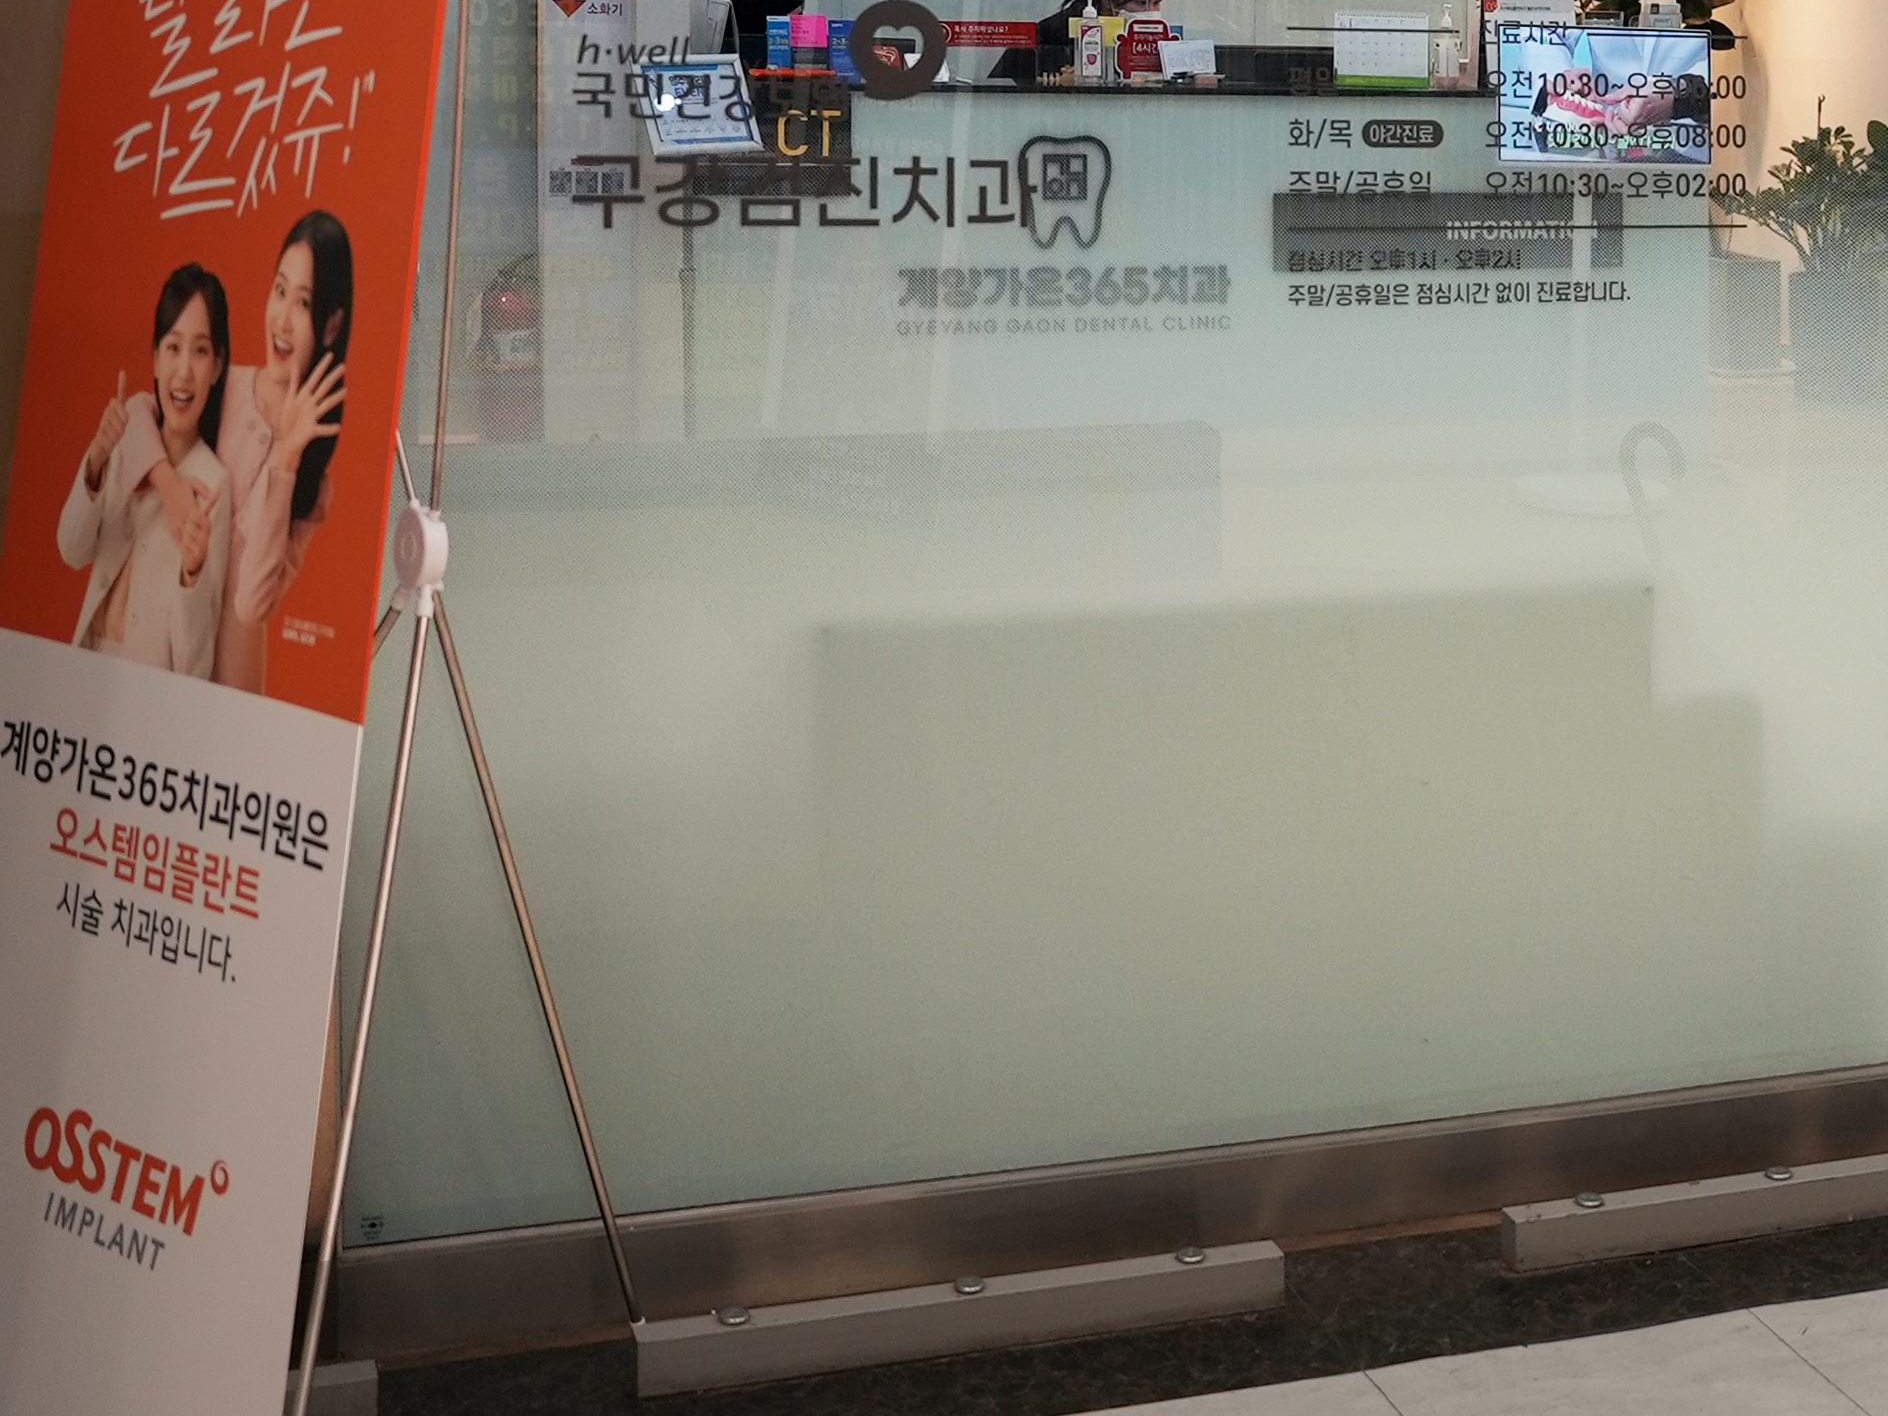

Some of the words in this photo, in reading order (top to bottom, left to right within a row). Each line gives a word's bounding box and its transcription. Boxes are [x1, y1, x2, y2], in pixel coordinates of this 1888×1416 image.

[587, 2, 623, 16] 소화기
[1481, 19, 1569, 46] 진료시간
[1289, 118, 1353, 150] 화/목
[1367, 124, 1435, 146] 야간진료
[571, 155, 1038, 230] 구강검진치과
[1288, 169, 1432, 197] 주말/공휴일
[898, 265, 1231, 308] 계양가온365치과
[1288, 283, 1410, 308] 주말/공휴일은
[1416, 282, 1490, 306] 점심시간
[1495, 282, 1531, 305] 없이
[1536, 280, 1632, 303] 진료합니다.
[2, 716, 330, 872] 계양가온365치과의원은
[50, 807, 261, 921] 오스템임플란트
[57, 881, 105, 936] 시술
[110, 899, 237, 983] 치과입니다.
[24, 1106, 204, 1238] OSSTEM
[43, 1192, 166, 1272] IMPLANT
